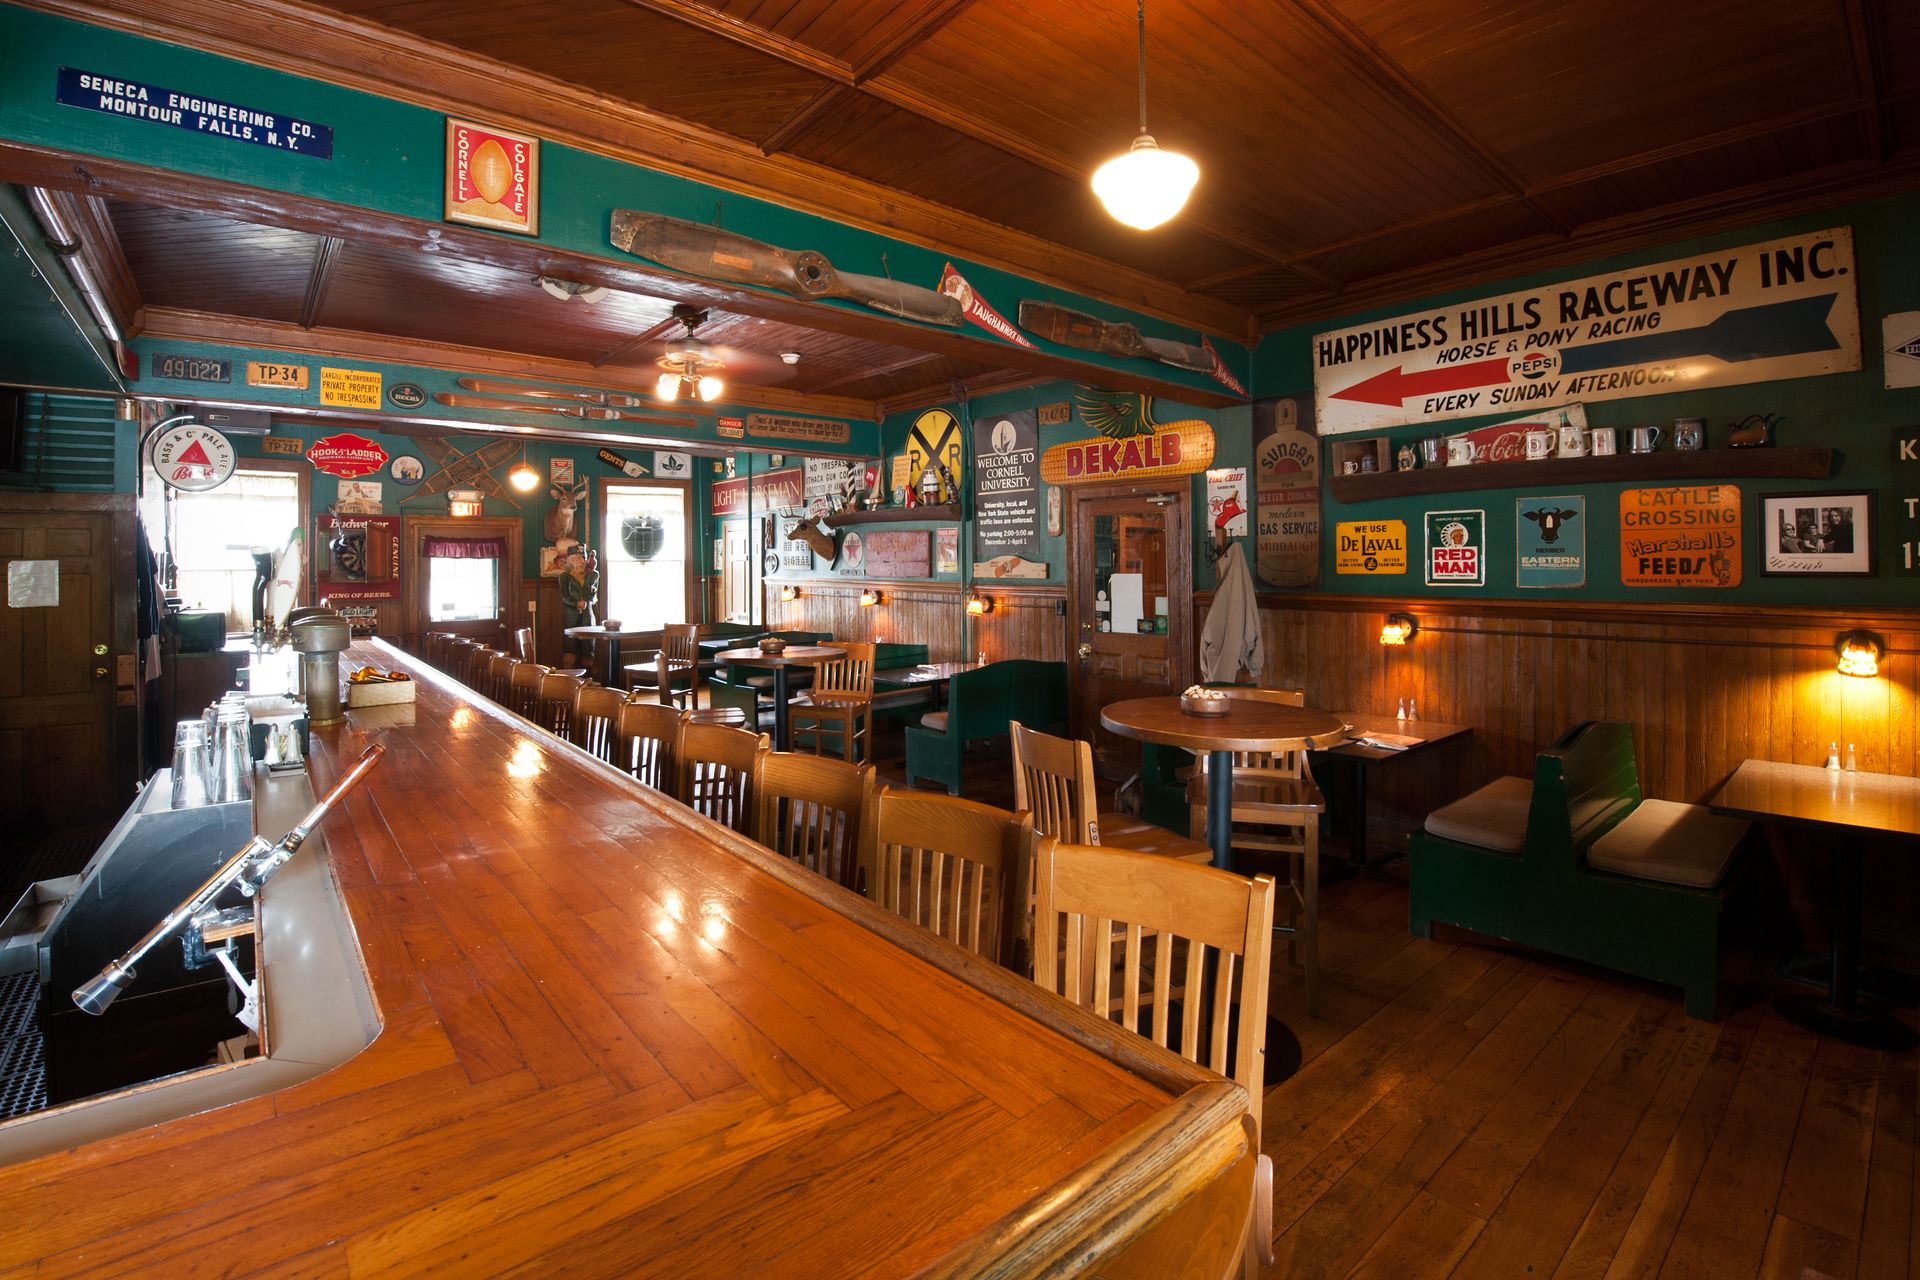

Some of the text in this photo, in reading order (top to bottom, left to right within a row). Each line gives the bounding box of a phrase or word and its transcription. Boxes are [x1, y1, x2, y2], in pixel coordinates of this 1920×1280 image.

[80, 74, 317, 139] SENECA ENGINEERING CO.
[100, 96, 182, 125] MONTOUR
[458, 129, 469, 201] CORNELL
[514, 143, 525, 213] COLGATE
[1319, 241, 1848, 368] HAPPINESS HILLS RACEWAY INC.
[972, 299, 1017, 340] TAUGHANNOCK
[1436, 311, 1661, 365] HORSE & PONY RACING
[1512, 357, 1557, 373] PEPSI
[321, 372, 381, 385] CARGILL INCORPORATED
[322, 381, 380, 394] PRIVATE PROPERTY
[1424, 366, 1680, 414] EVERY SUNDAY AFTERNOON
[325, 391, 377, 405] NO TRESPASSING
[719, 419, 742, 428] DANGER
[161, 431, 229, 470] BASS & PALE ALE
[311, 448, 338, 460] HOOK
[346, 449, 384, 462] LADDER
[599, 450, 625, 467] GENTS
[910, 444, 961, 472] R R
[1066, 433, 1182, 476] DEKALB
[810, 464, 818, 472] NO
[978, 453, 1035, 469] WELCOME TO
[826, 473, 836, 481] GUN
[987, 466, 1025, 479] CORNELL
[1225, 473, 1245, 482] CHIEF
[981, 477, 1031, 490] UNIVERSITY
[714, 480, 801, 507] LIGHT HORSEMAN
[1638, 490, 1721, 506] CATTLE
[453, 502, 481, 517] EXIT
[984, 501, 1005, 509] University,
[1019, 499, 1028, 507] and
[1026, 507, 1036, 515] and
[1625, 509, 1736, 526] CROSSING
[1260, 522, 1318, 535] GAS SERVICE
[1369, 525, 1387, 533] USE
[1626, 530, 1735, 557] Marshall's
[392, 537, 400, 580] GENUINE
[1434, 549, 1476, 561] RED
[1434, 562, 1475, 574] MAN
[1640, 557, 1706, 575] FEEDS
